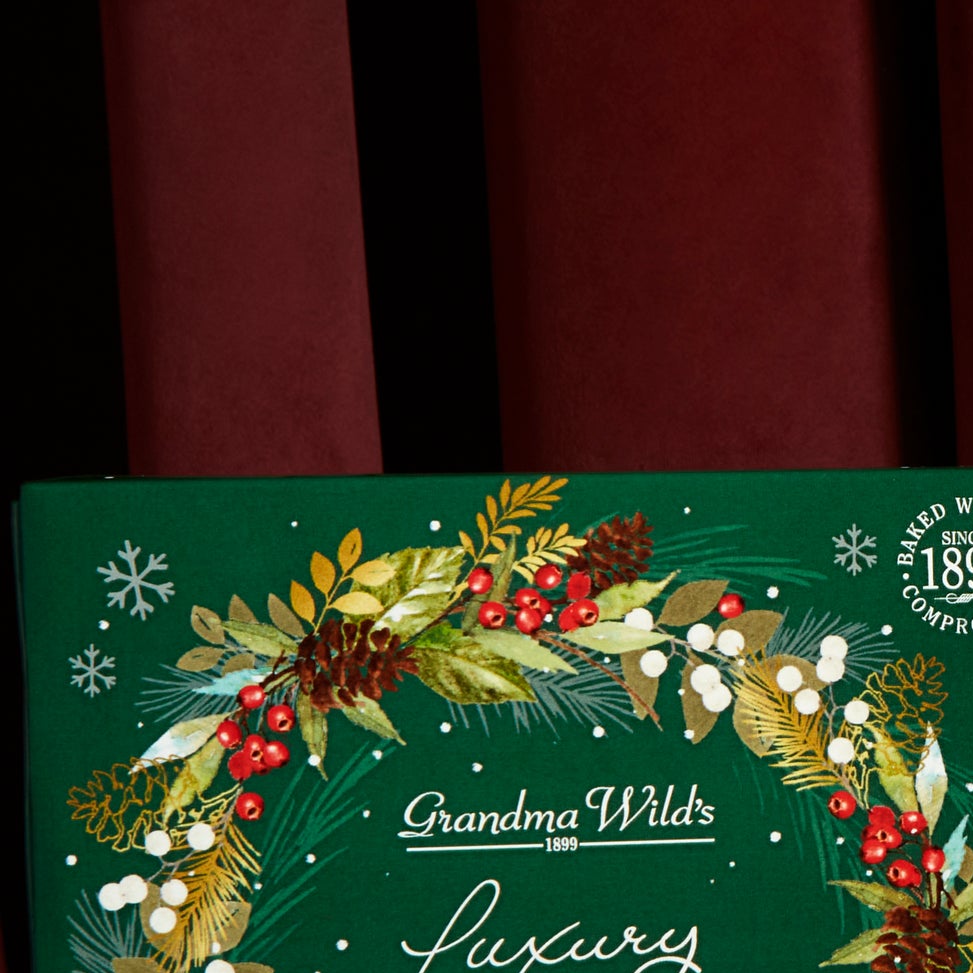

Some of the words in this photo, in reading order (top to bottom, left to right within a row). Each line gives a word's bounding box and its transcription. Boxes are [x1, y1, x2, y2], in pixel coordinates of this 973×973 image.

[897, 503, 946, 566] BAKED
[398, 789, 578, 838] Grandma
[586, 784, 715, 832] Wild's
[545, 836, 578, 852] 1899
